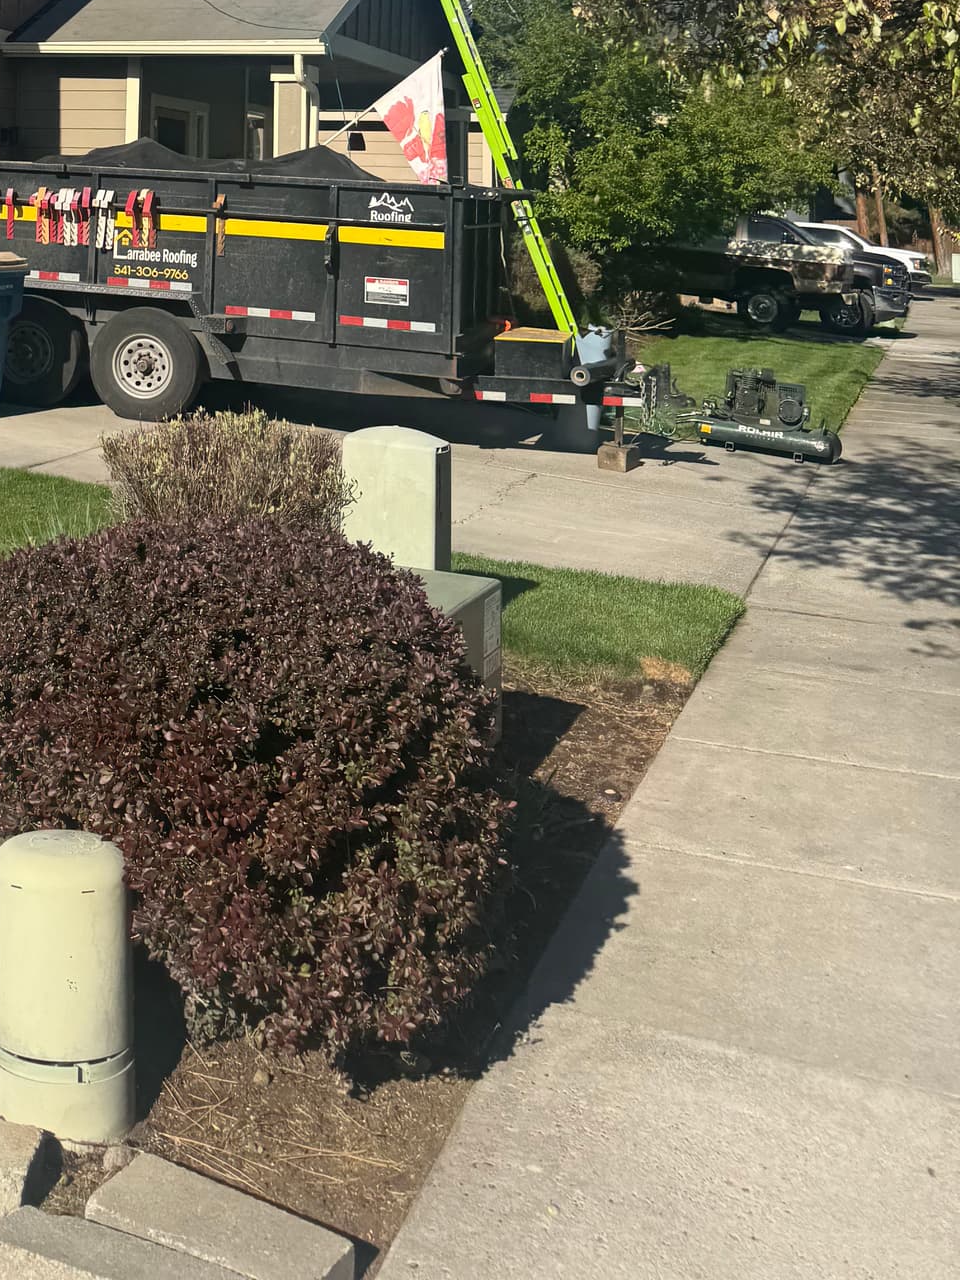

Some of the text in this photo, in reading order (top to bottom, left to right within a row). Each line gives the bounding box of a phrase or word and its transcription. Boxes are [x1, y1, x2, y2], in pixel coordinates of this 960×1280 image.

[370, 210, 412, 223] Roofing
[113, 229, 198, 268] Larrabee Roofing
[113, 263, 189, 280] 541-306-9766
